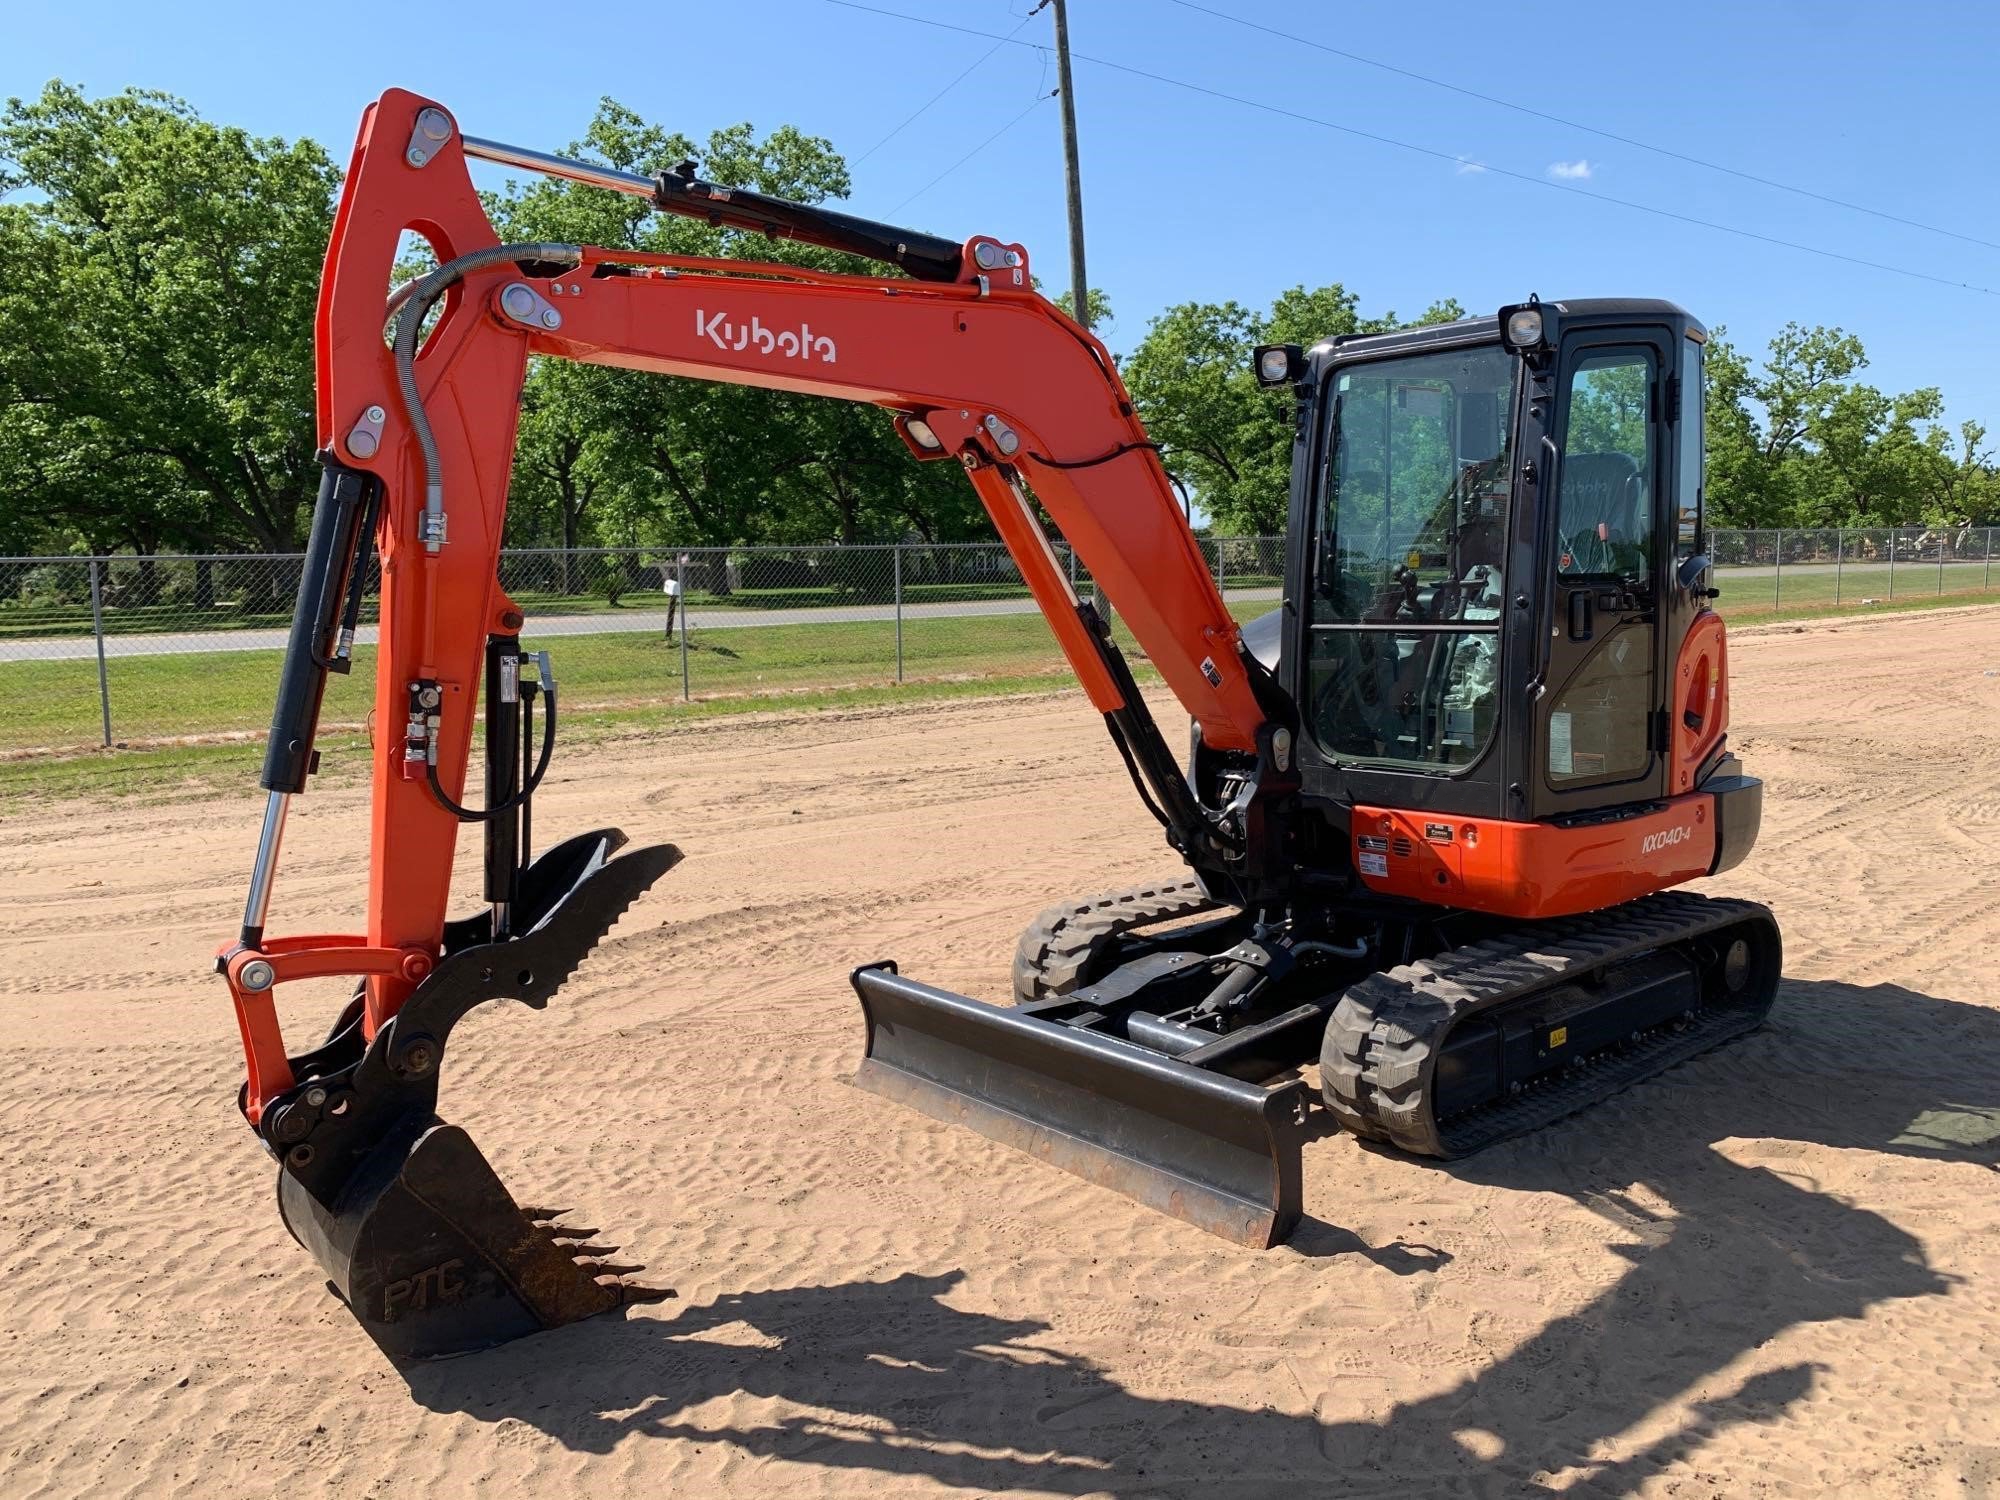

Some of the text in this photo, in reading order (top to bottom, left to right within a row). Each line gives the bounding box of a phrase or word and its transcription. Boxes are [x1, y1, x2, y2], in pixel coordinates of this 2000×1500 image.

[696, 309, 836, 363] Kubota
[1642, 826, 1691, 854] KX040-4
[384, 1257, 466, 1322] PTC
